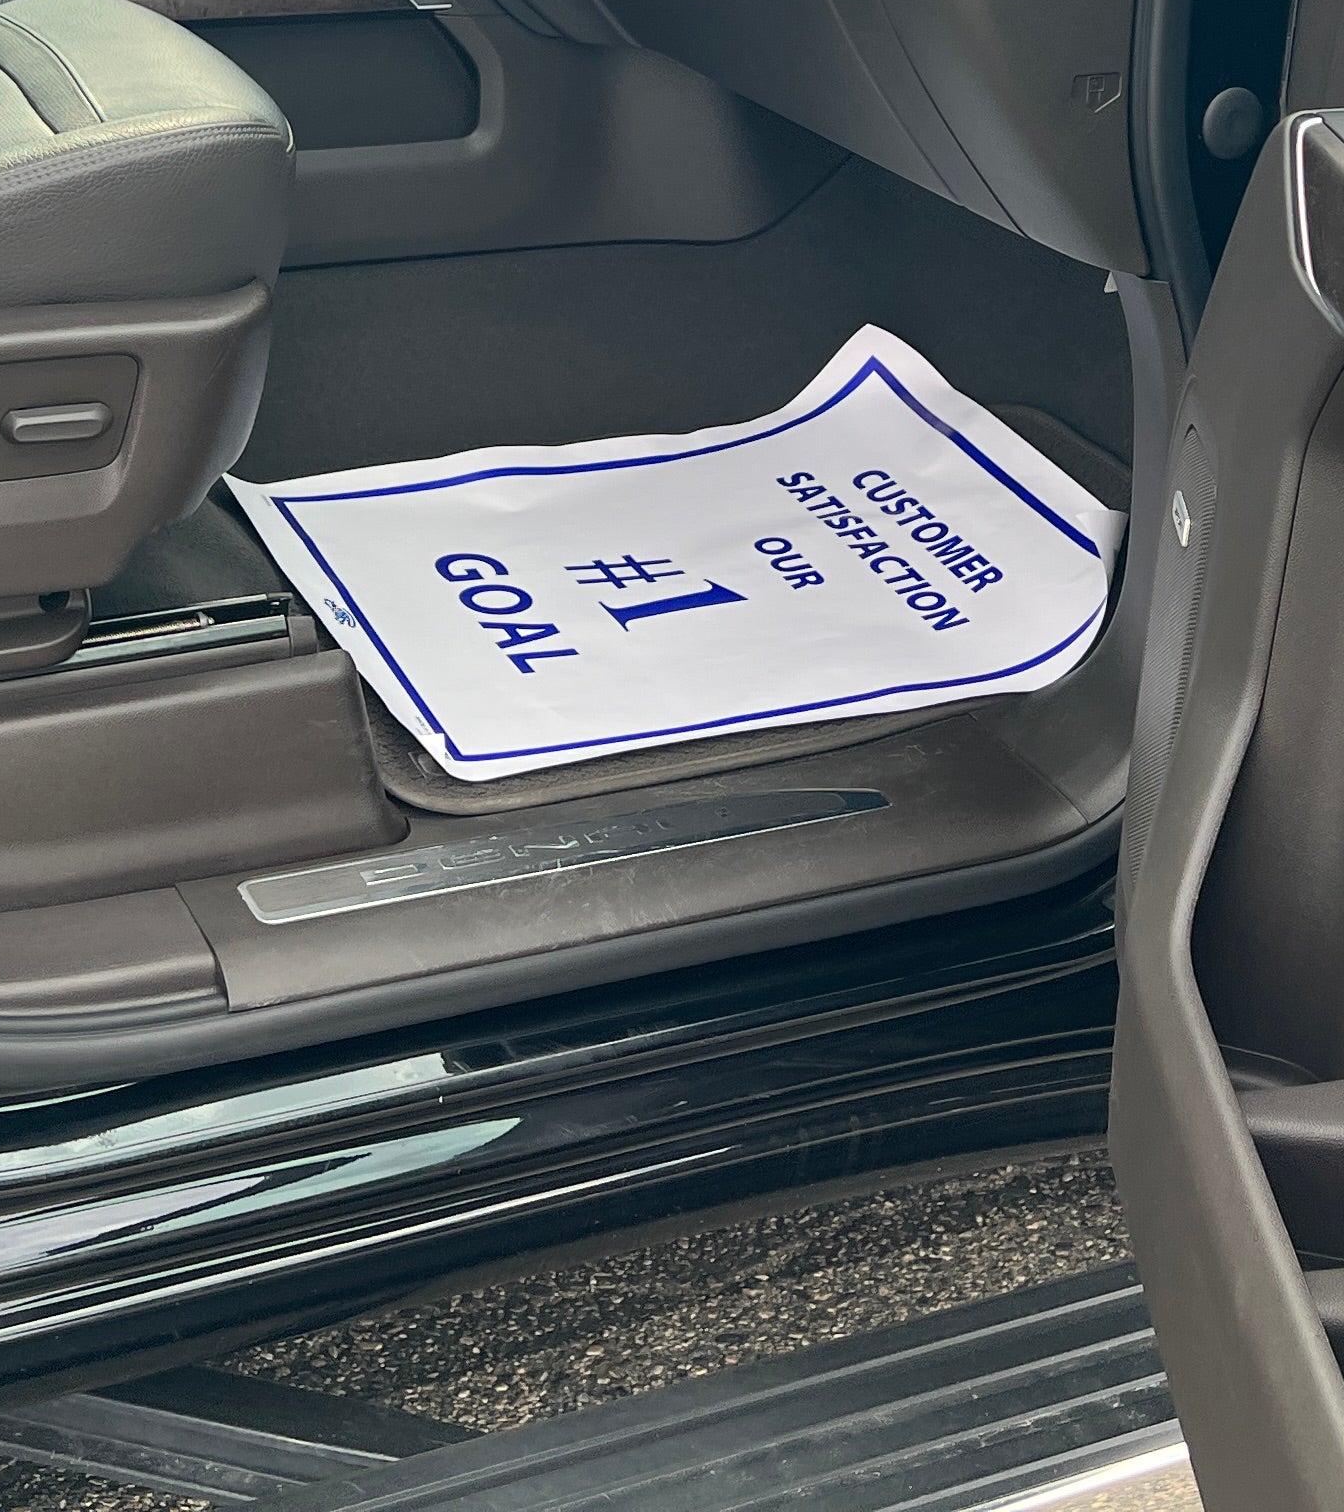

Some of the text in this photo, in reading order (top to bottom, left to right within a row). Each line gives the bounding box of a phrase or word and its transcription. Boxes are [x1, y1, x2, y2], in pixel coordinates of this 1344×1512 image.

[753, 537, 825, 590] OUR
[775, 471, 971, 631] SATISFACTION
[852, 469, 1004, 593] CUSTOMER
[434, 553, 580, 674] GOAL
[563, 554, 749, 632] #1
